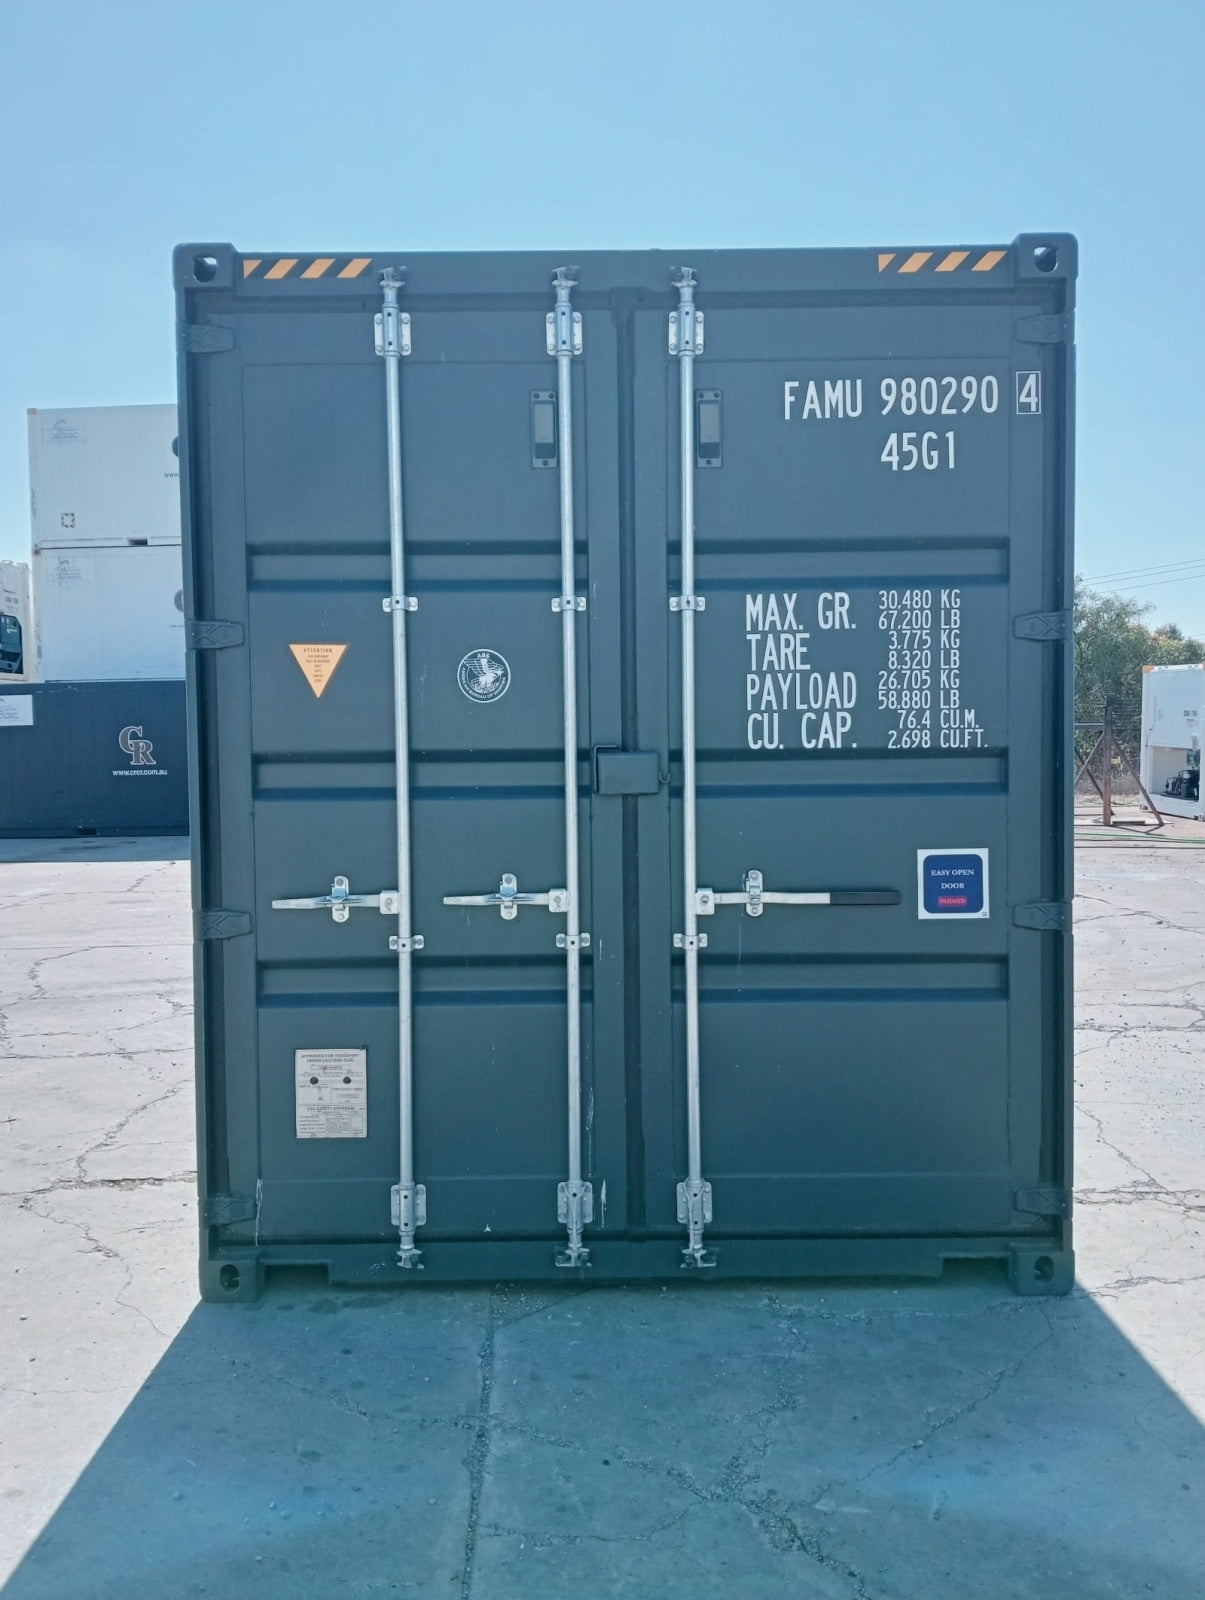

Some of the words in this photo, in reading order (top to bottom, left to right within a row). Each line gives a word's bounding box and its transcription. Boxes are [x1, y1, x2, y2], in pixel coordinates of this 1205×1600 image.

[784, 377, 863, 420] FAMU
[880, 375, 999, 416] 980290
[1019, 373, 1039, 412] 4
[880, 431, 956, 471] 45G1
[745, 592, 804, 632] MAX.
[817, 591, 857, 630] GR.
[878, 588, 932, 610] 30,480
[940, 588, 961, 609] KG
[878, 609, 932, 630] 67,200
[940, 608, 961, 629] LB
[745, 632, 811, 672] TARE
[888, 629, 932, 650] 3,775
[940, 629, 961, 649] KG
[887, 649, 932, 670] 8,320
[940, 649, 961, 669] LB
[746, 671, 857, 711] PAYLOAD
[878, 670, 932, 690] 26,705
[940, 669, 961, 689] KG
[878, 690, 932, 710] 58,880
[939, 689, 960, 709] LB
[747, 712, 785, 750] CU.
[801, 711, 858, 749] CAP.
[897, 709, 931, 730] 76.4
[940, 708, 980, 729] CU.M.
[887, 729, 932, 749] 2,698
[940, 728, 989, 749] CU.FT.
